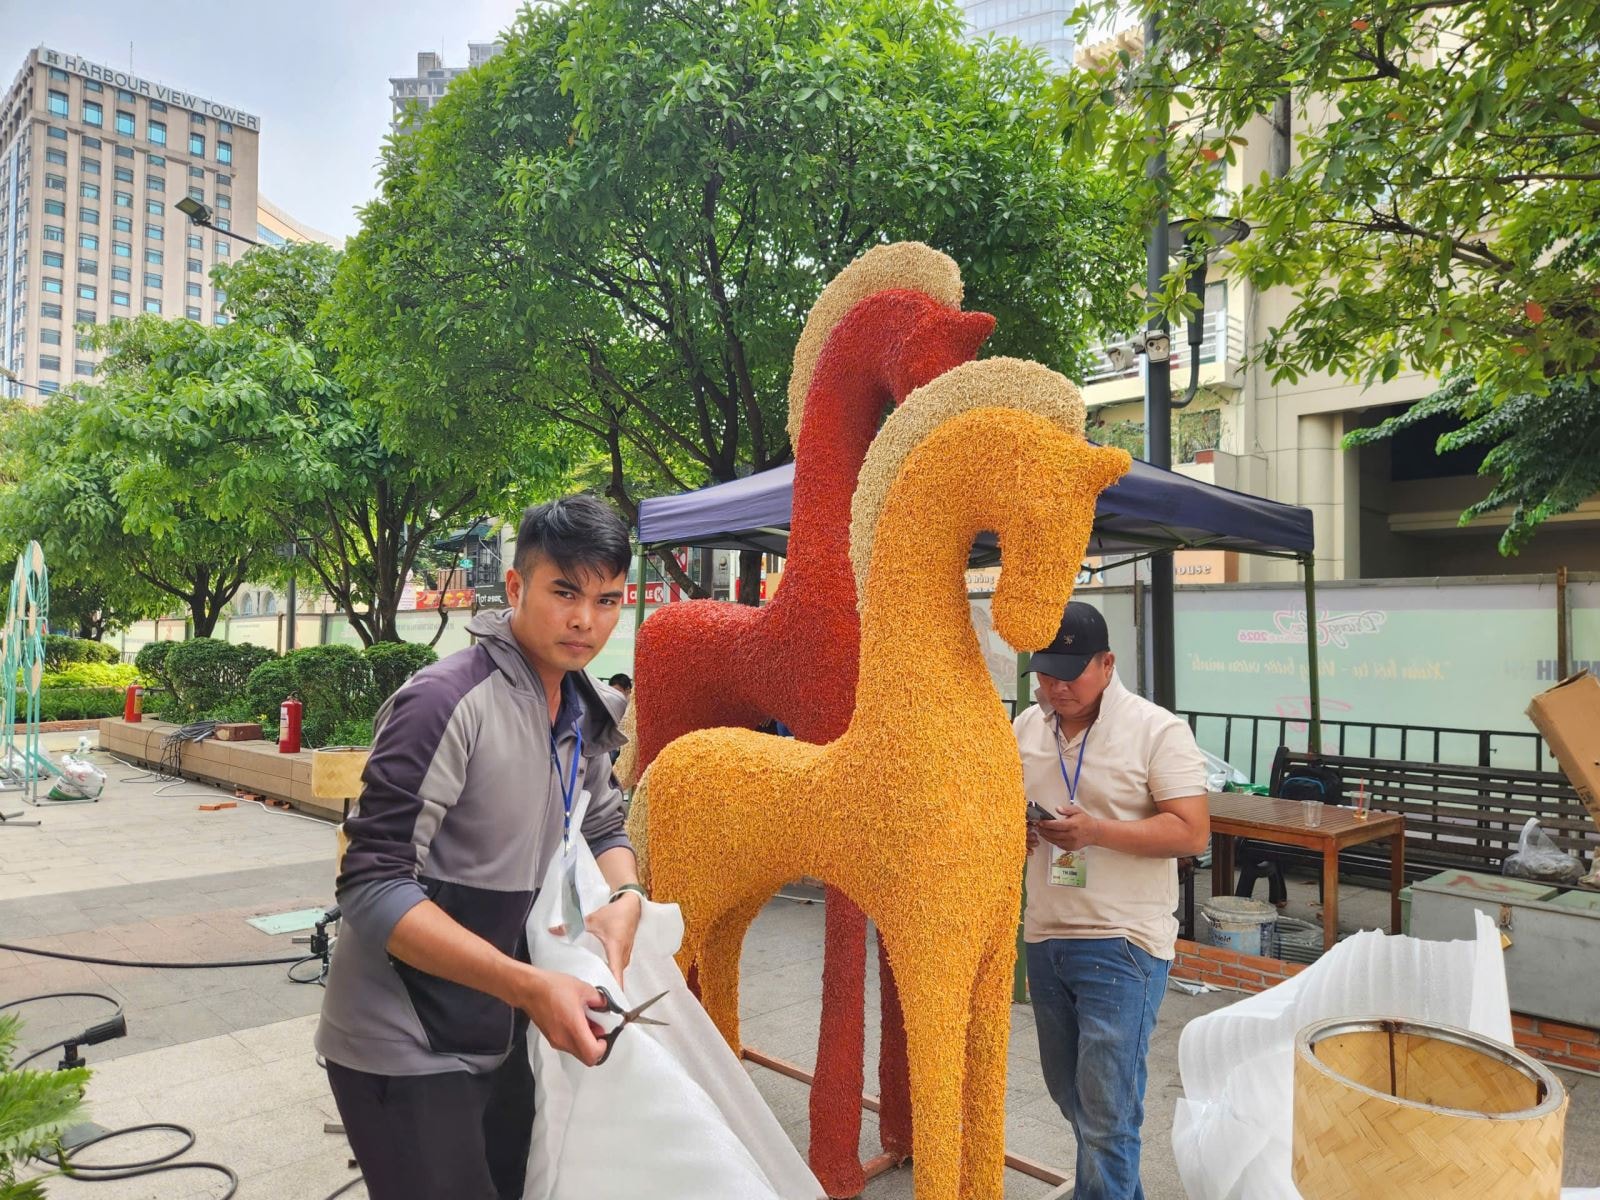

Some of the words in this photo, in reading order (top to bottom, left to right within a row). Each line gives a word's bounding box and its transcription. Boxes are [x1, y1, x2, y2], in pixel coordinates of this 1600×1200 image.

[65, 55, 150, 96] HARBOUR
[156, 85, 197, 109] VIEW
[202, 100, 257, 129] TOWER
